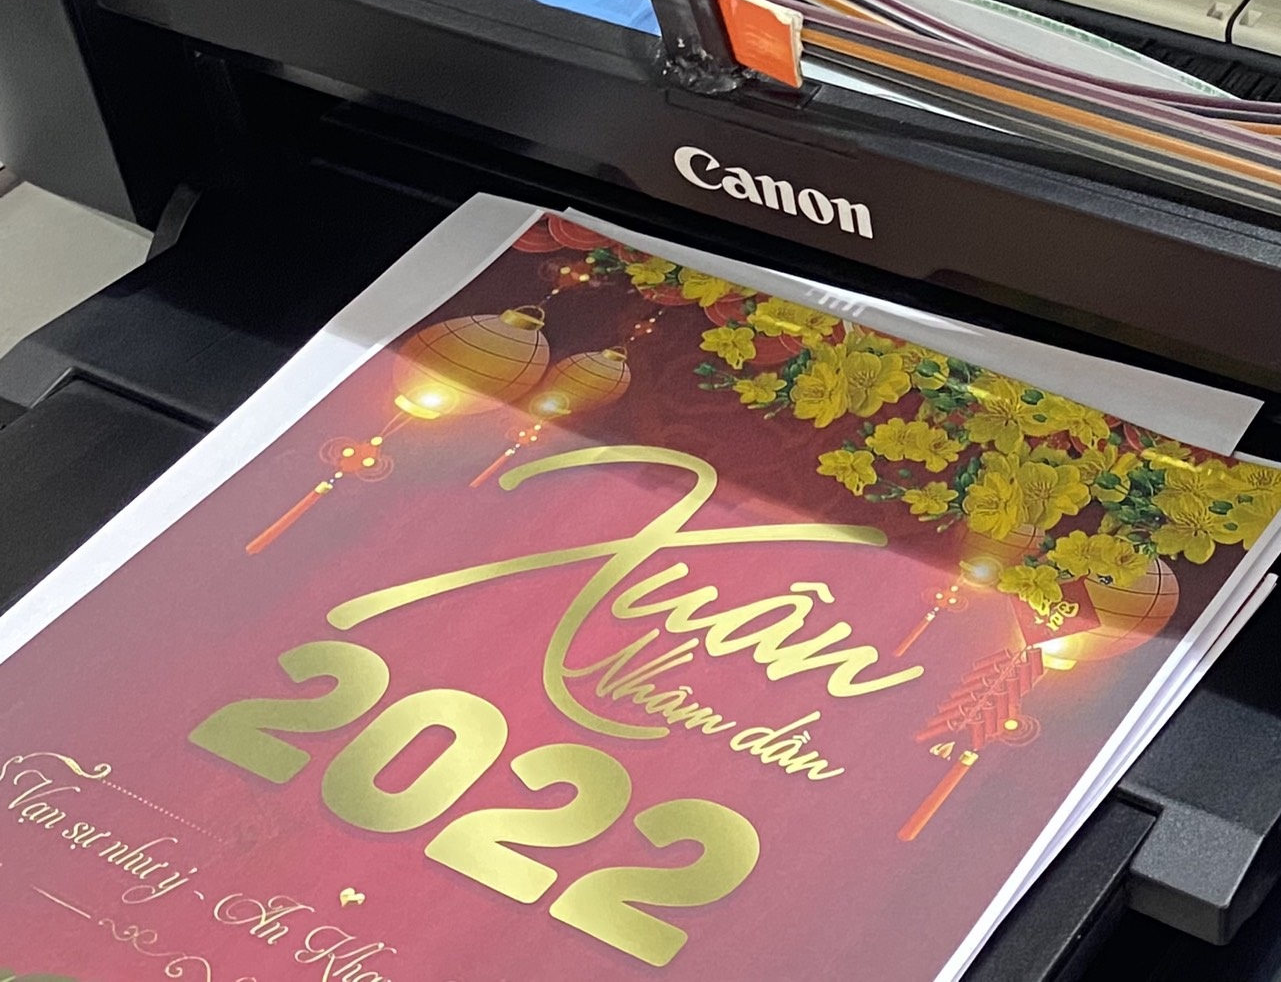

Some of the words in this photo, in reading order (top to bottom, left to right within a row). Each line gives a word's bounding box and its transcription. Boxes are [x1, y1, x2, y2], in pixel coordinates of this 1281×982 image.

[673, 145, 874, 239] Canon
[327, 445, 924, 740] Xuân
[561, 628, 737, 735] Nhâm
[730, 710, 846, 781] dần
[8, 769, 81, 829] Vạn
[62, 822, 111, 850] sự
[99, 837, 178, 880] như
[213, 893, 315, 945] An
[187, 640, 761, 967] 2022
